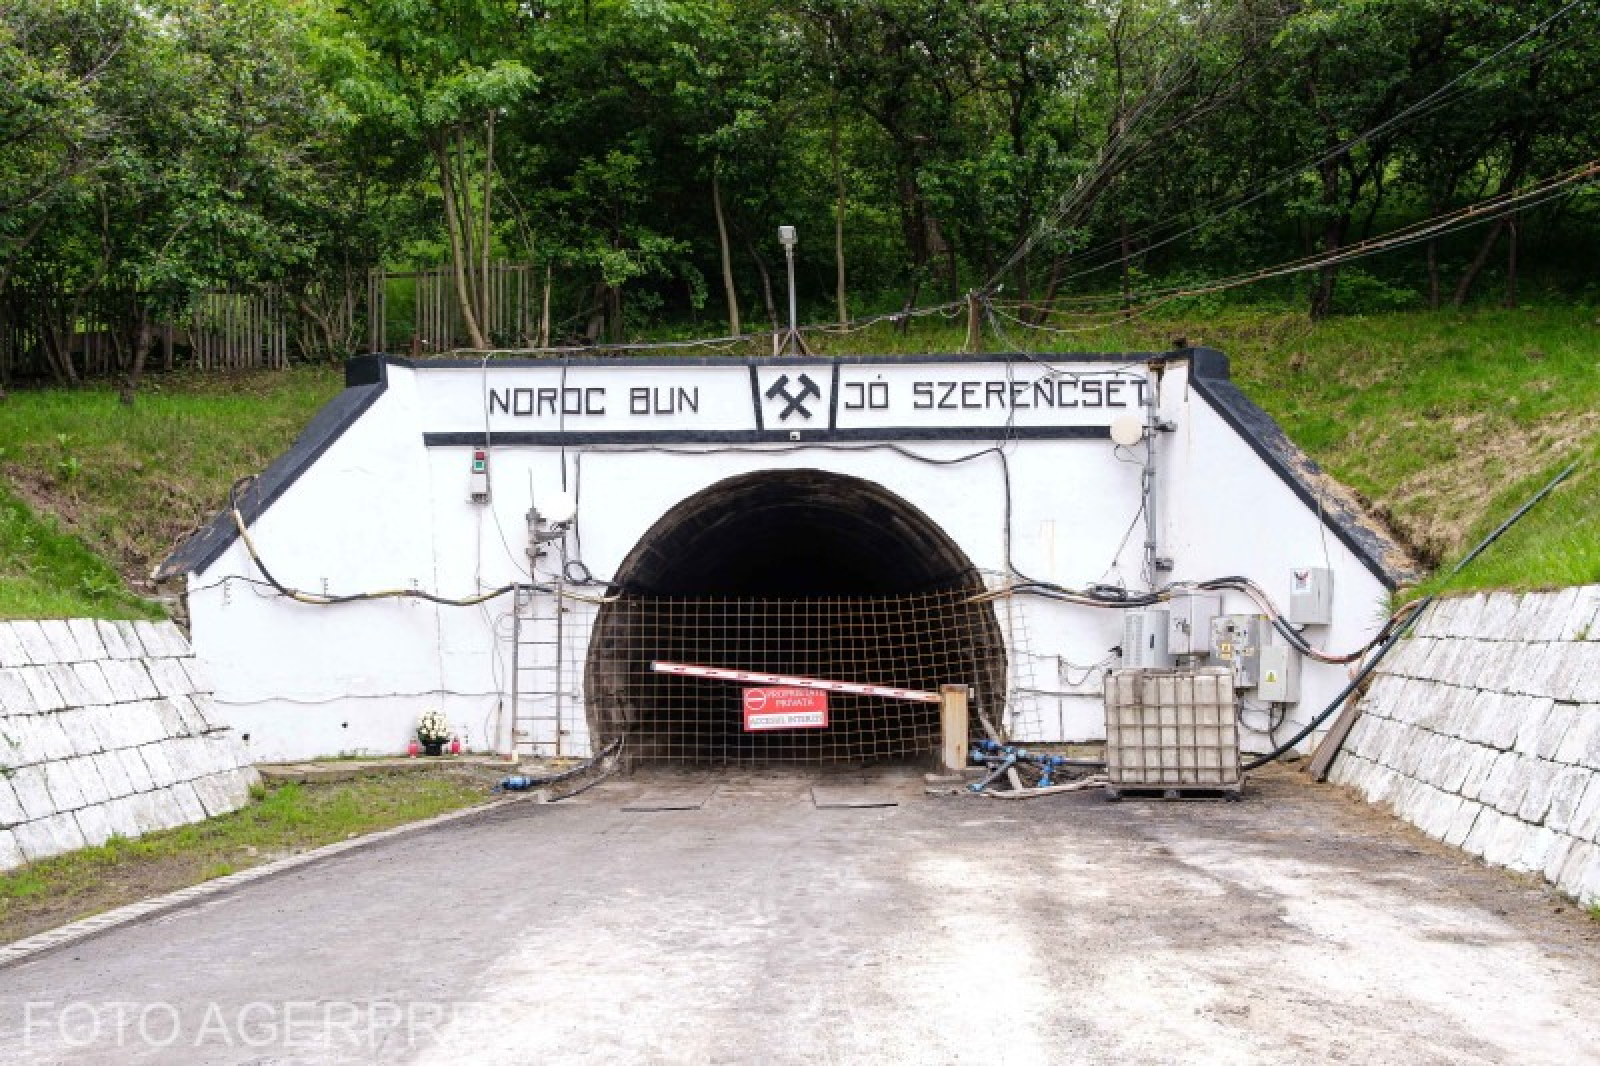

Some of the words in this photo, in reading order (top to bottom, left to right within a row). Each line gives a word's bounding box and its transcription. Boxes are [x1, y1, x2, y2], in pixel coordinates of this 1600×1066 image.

[489, 387, 606, 416] NOROC
[629, 386, 699, 414] BUN
[844, 374, 889, 410] JÓ
